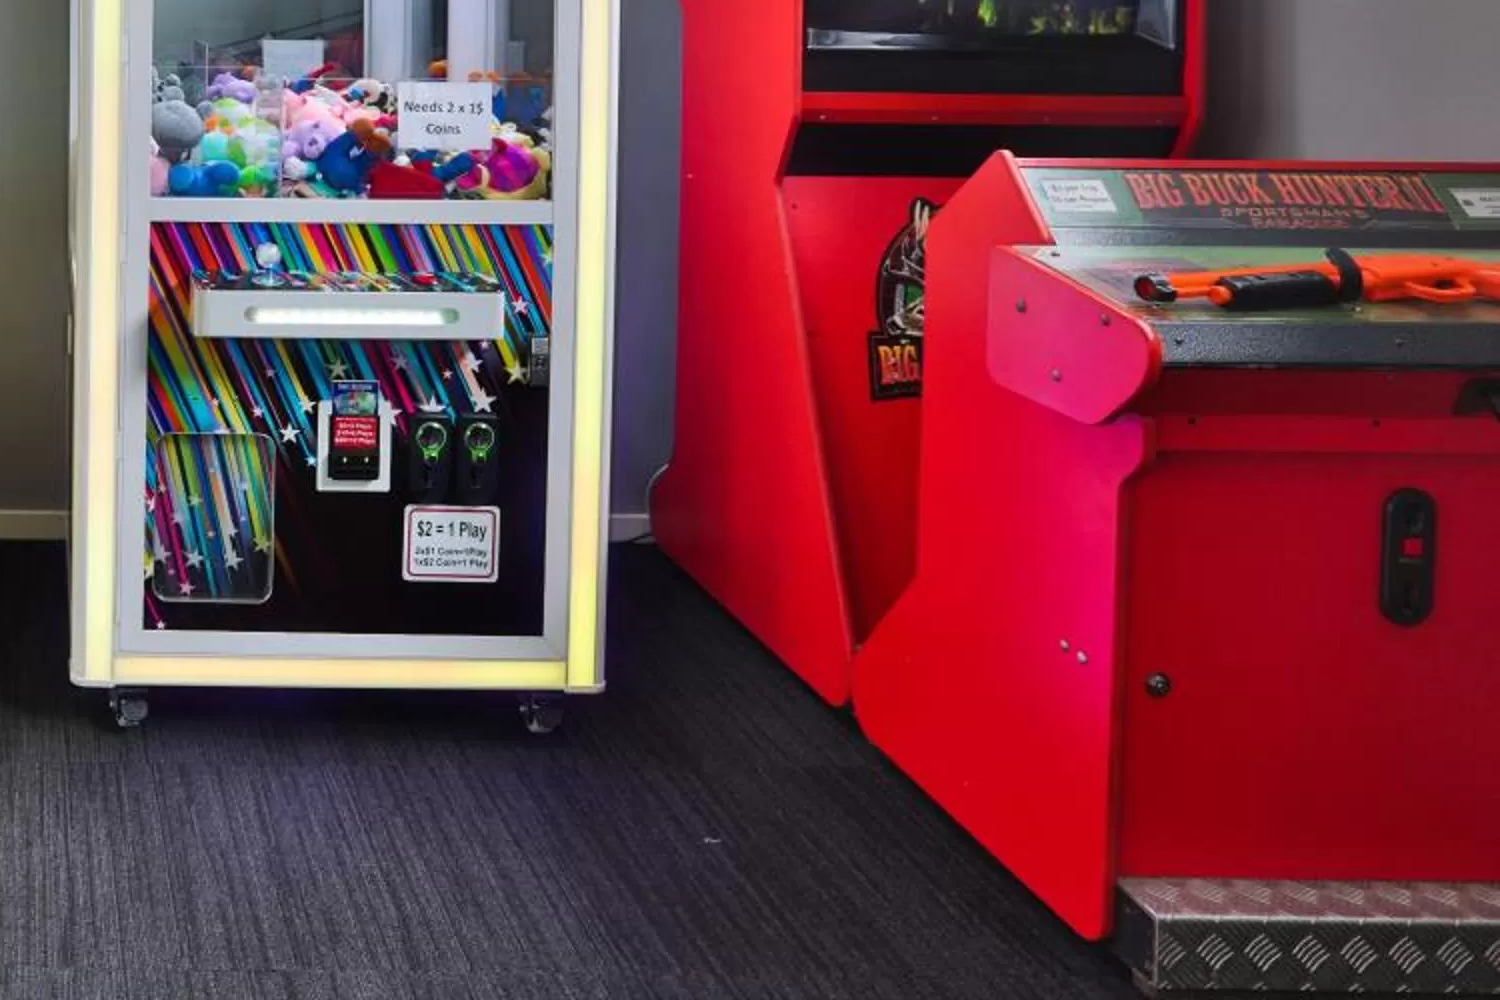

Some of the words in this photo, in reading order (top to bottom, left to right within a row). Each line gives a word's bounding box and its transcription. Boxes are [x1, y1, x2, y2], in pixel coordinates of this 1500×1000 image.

[403, 101, 444, 113] Needs
[447, 101, 456, 113] 2
[458, 104, 465, 113] x
[426, 123, 462, 135] Coins
[1124, 173, 1186, 208] BIG
[1180, 172, 1276, 206] BUCK
[877, 345, 920, 385] BIG
[417, 520, 433, 537] $2
[448, 521, 455, 537] 1
[459, 521, 487, 542] Play
